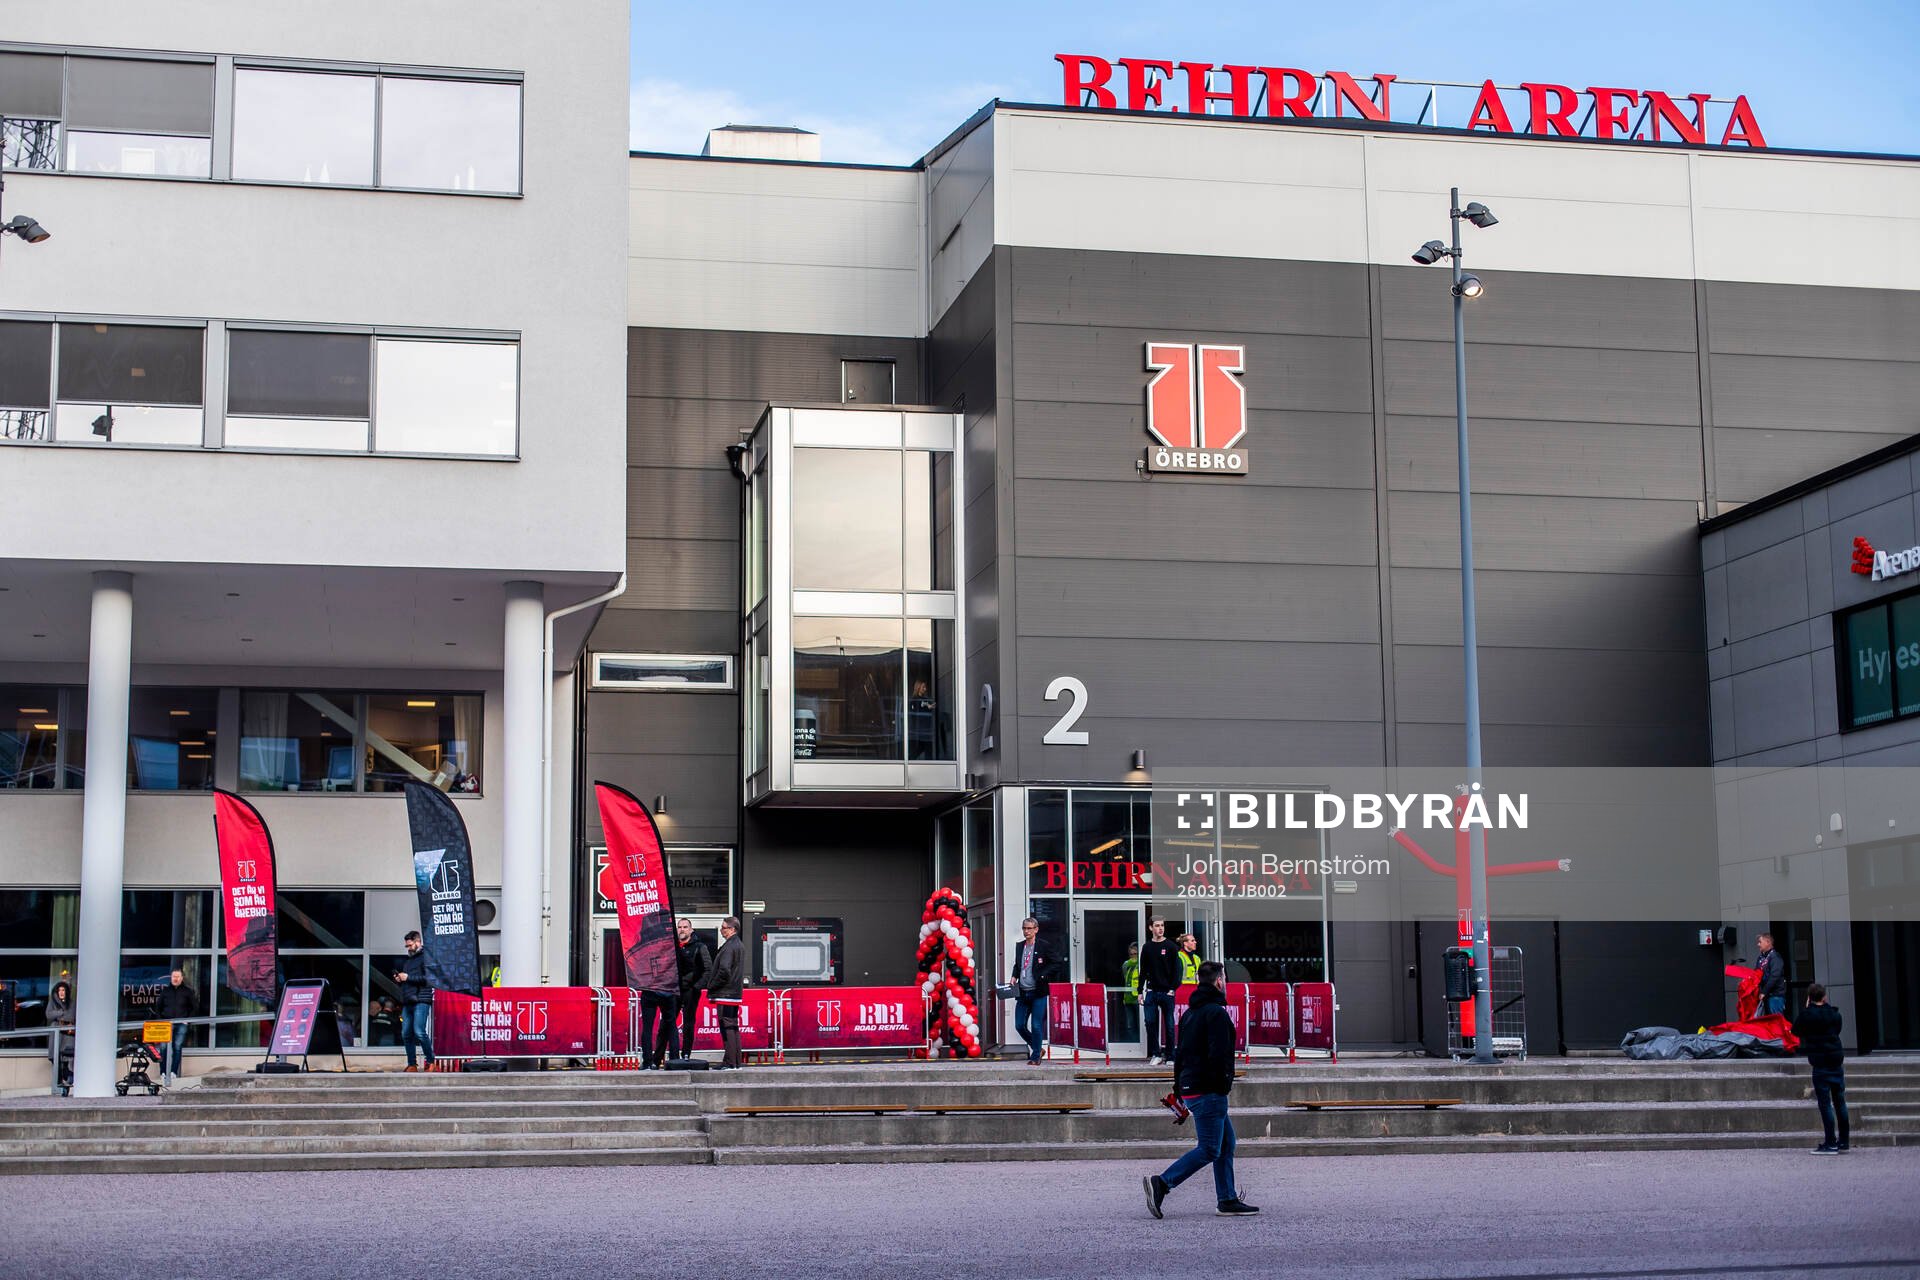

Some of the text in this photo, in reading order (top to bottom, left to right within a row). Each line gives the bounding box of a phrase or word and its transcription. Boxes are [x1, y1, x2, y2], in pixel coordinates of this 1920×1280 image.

[1054, 53, 1767, 148] BEHRN ARENA
[1156, 448, 1242, 469] ÖREBRO
[1043, 677, 1089, 745] 2
[1044, 861, 1176, 889] BEHRN
[232, 887, 246, 895] DET
[257, 885, 265, 894] VI
[623, 879, 657, 892] DET ÄR VI
[233, 894, 266, 906] SOM ÄR
[625, 889, 659, 904] SOM ÄR
[235, 906, 267, 918] ÖREBRO
[432, 902, 463, 913] DET ÄR VI
[627, 901, 660, 917] ÖREBRO
[433, 911, 463, 924] SOM ÄR
[434, 924, 464, 935] ÖREBRO
[132, 996, 160, 1004] LOUN
[471, 999, 512, 1012] DET ÄR VI
[471, 1011, 512, 1027] SOM ÄR
[471, 1027, 512, 1041] ÖREBRO
[854, 1024, 877, 1032] ROAD
